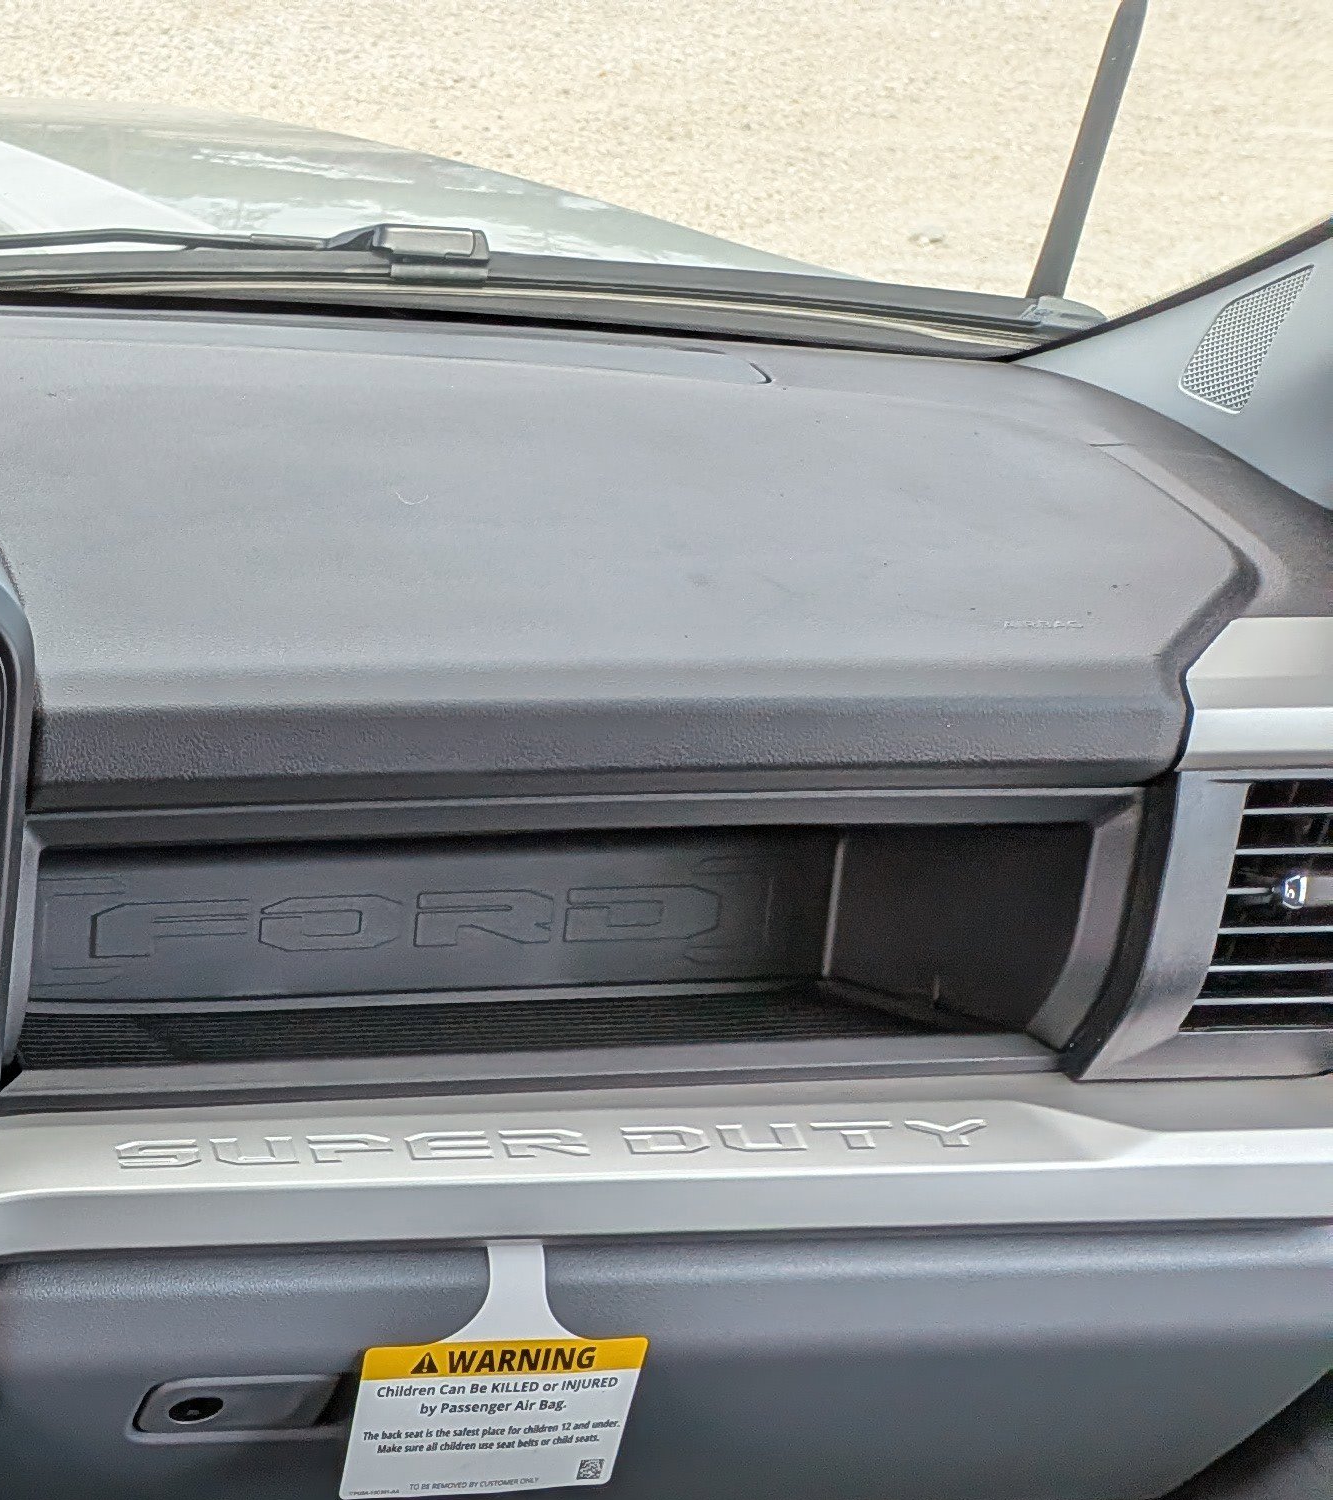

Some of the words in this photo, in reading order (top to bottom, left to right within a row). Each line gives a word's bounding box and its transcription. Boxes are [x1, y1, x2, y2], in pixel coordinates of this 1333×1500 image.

[90, 880, 723, 961] FORD
[113, 1126, 592, 1173] SUPER
[622, 1114, 989, 1158] DUTY
[448, 1345, 597, 1375] WARNING
[376, 1384, 436, 1399] Children
[439, 1384, 466, 1396] Can
[469, 1382, 487, 1395] Be
[490, 1380, 540, 1394] KILLED
[542, 1382, 560, 1393] or
[560, 1376, 619, 1393] INJURED
[419, 1402, 437, 1417] by
[440, 1401, 513, 1417] Passenger
[514, 1400, 537, 1411] Air
[538, 1398, 568, 1413] Bag.
[362, 1430, 379, 1441] The
[381, 1429, 402, 1440] back
[404, 1429, 424, 1439] seat
[425, 1428, 434, 1438] is
[435, 1428, 451, 1438] the
[452, 1427, 480, 1438] safest
[481, 1426, 506, 1438] place
[507, 1425, 522, 1436] for
[523, 1423, 559, 1435] children
[561, 1422, 571, 1432] 12
[572, 1421, 591, 1431] and
[591, 1418, 621, 1430] under.
[376, 1444, 402, 1454] Make
[404, 1443, 424, 1453] sure
[425, 1441, 438, 1452] all
[439, 1440, 476, 1452] children
[478, 1440, 494, 1450] use
[496, 1439, 515, 1450] seat
[516, 1438, 539, 1449] belts
[540, 1437, 551, 1447] or
[552, 1435, 573, 1446] child
[575, 1433, 601, 1444] seats.
[409, 1483, 420, 1491] TO
[421, 1482, 430, 1490] BE
[431, 1481, 467, 1490] REMOVED
[468, 1480, 479, 1488] BY
[479, 1478, 519, 1488] CUSTOMER
